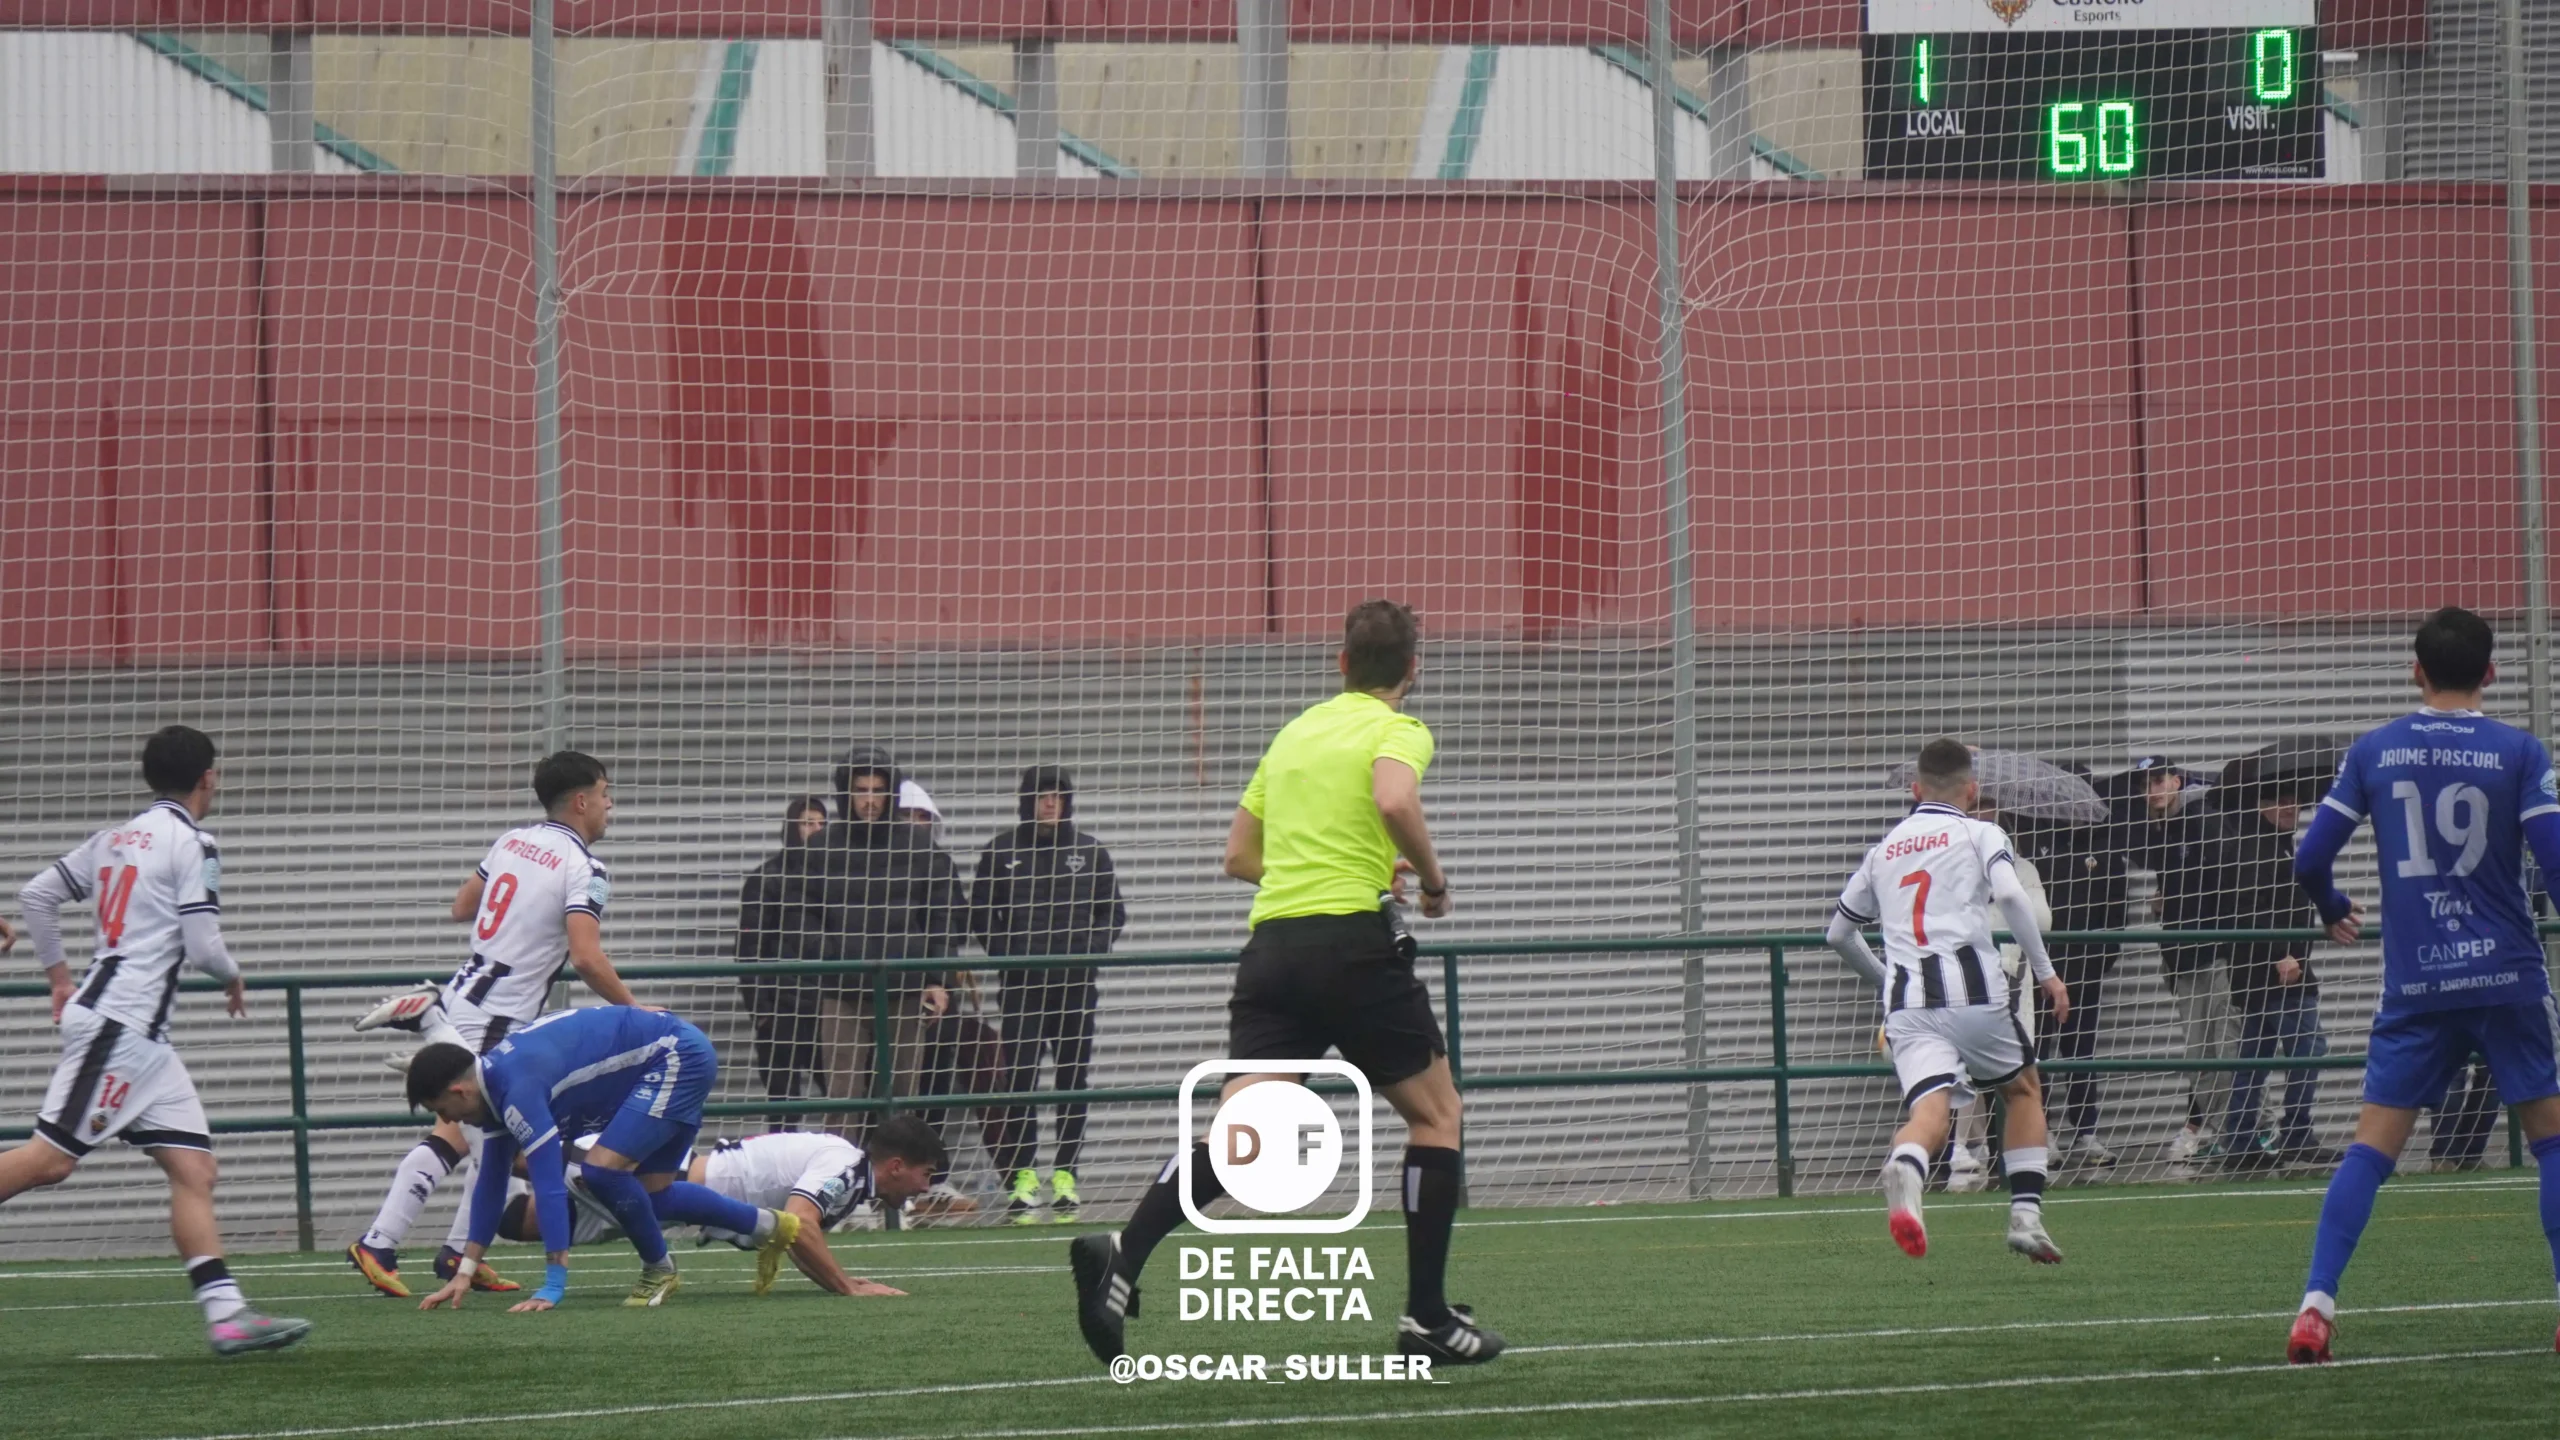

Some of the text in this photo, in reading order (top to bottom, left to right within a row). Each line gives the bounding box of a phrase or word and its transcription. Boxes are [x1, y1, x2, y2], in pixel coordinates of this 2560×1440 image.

[2074, 9, 2121, 24] Esports
[1918, 39, 1928, 103] 1
[2255, 29, 2292, 99] 0
[1906, 110, 1966, 137] LOCAL
[2050, 102, 2134, 172] 60
[2227, 105, 2277, 132] VISIT.
[2377, 748, 2503, 770] JAUME PASCUAL
[1885, 832, 1949, 861] SEGURA
[2392, 781, 2490, 878] 19
[98, 864, 138, 949] 14
[477, 872, 518, 941] 9
[1898, 869, 1932, 947] 7
[2417, 939, 2496, 964] CANPEP
[2401, 983, 2428, 996] VISIT
[98, 1074, 131, 1116] 14
